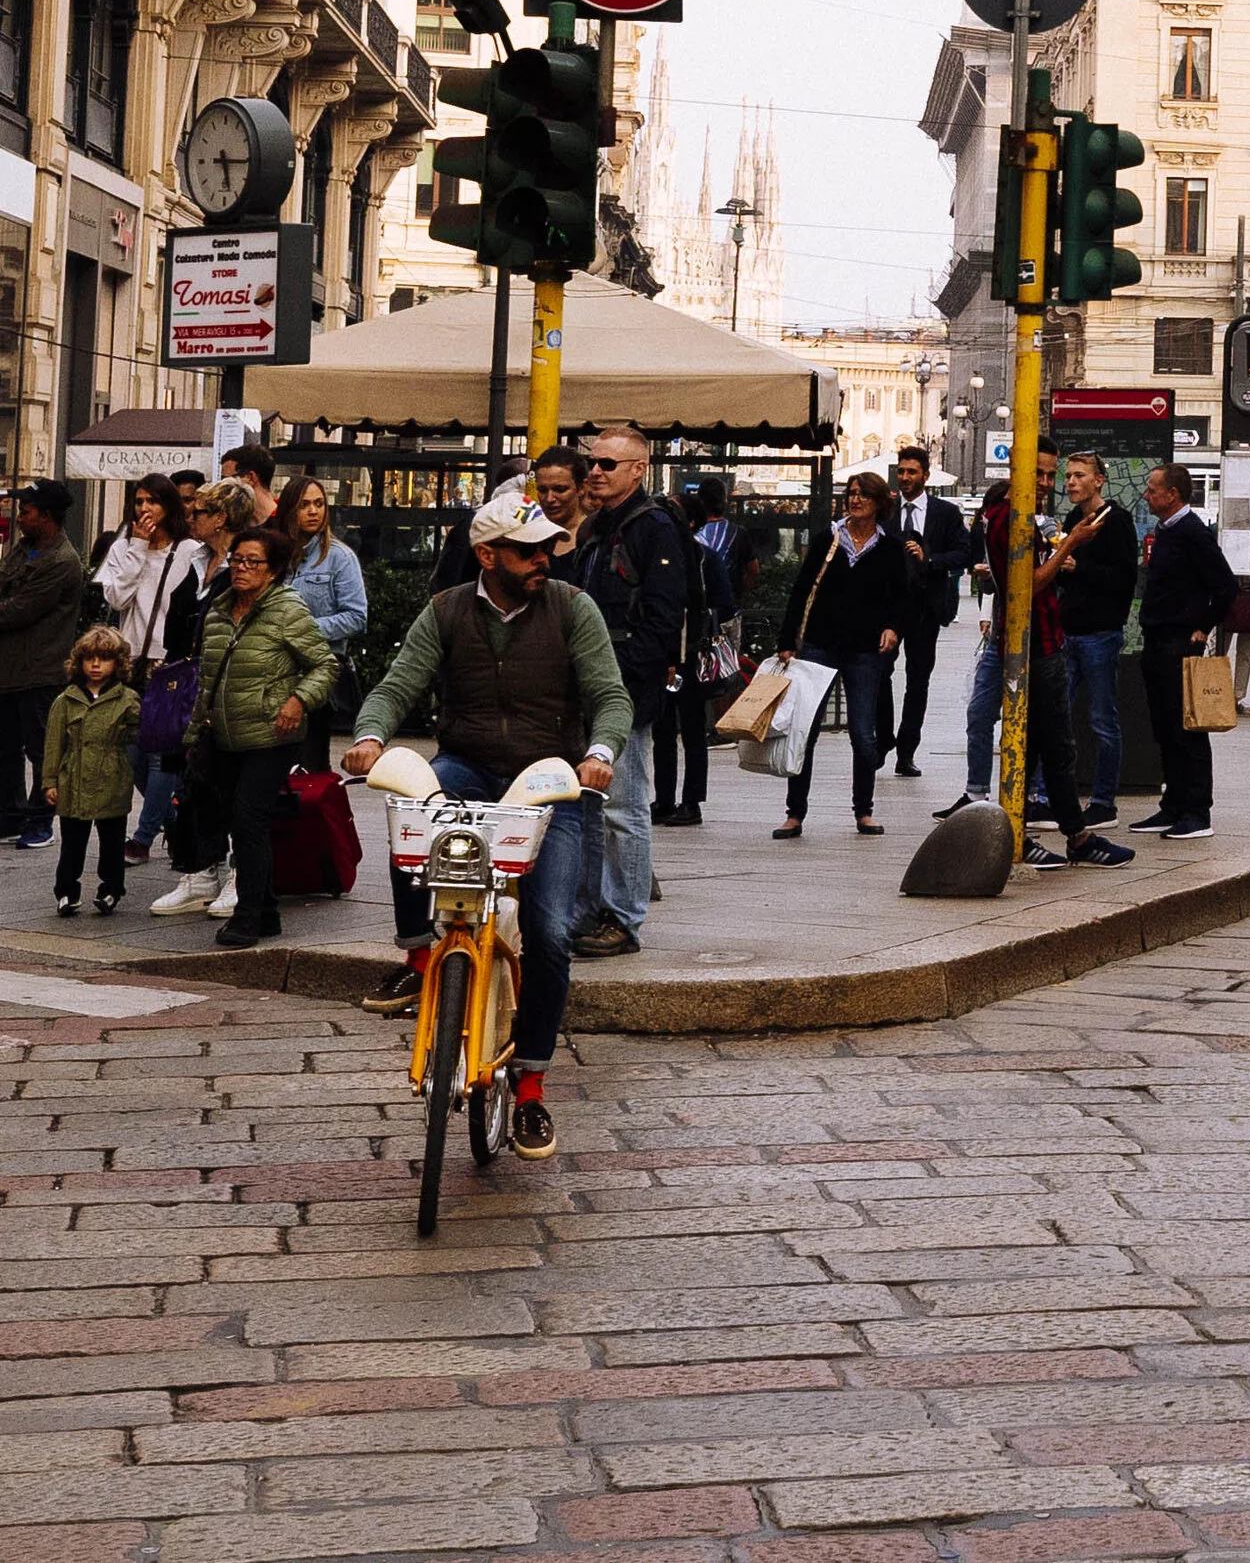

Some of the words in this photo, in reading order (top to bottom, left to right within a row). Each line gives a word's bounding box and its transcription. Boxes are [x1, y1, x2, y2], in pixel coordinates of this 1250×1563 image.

[212, 239, 240, 248] Centro
[175, 253, 214, 263] Calzature
[217, 252, 240, 261] Moda
[243, 250, 276, 260] Comoda
[211, 269, 238, 278] STORE
[173, 280, 252, 307] Tomasi
[177, 328, 189, 337] VIA
[177, 340, 214, 354] Marro
[106, 451, 186, 466] GRANAIO
